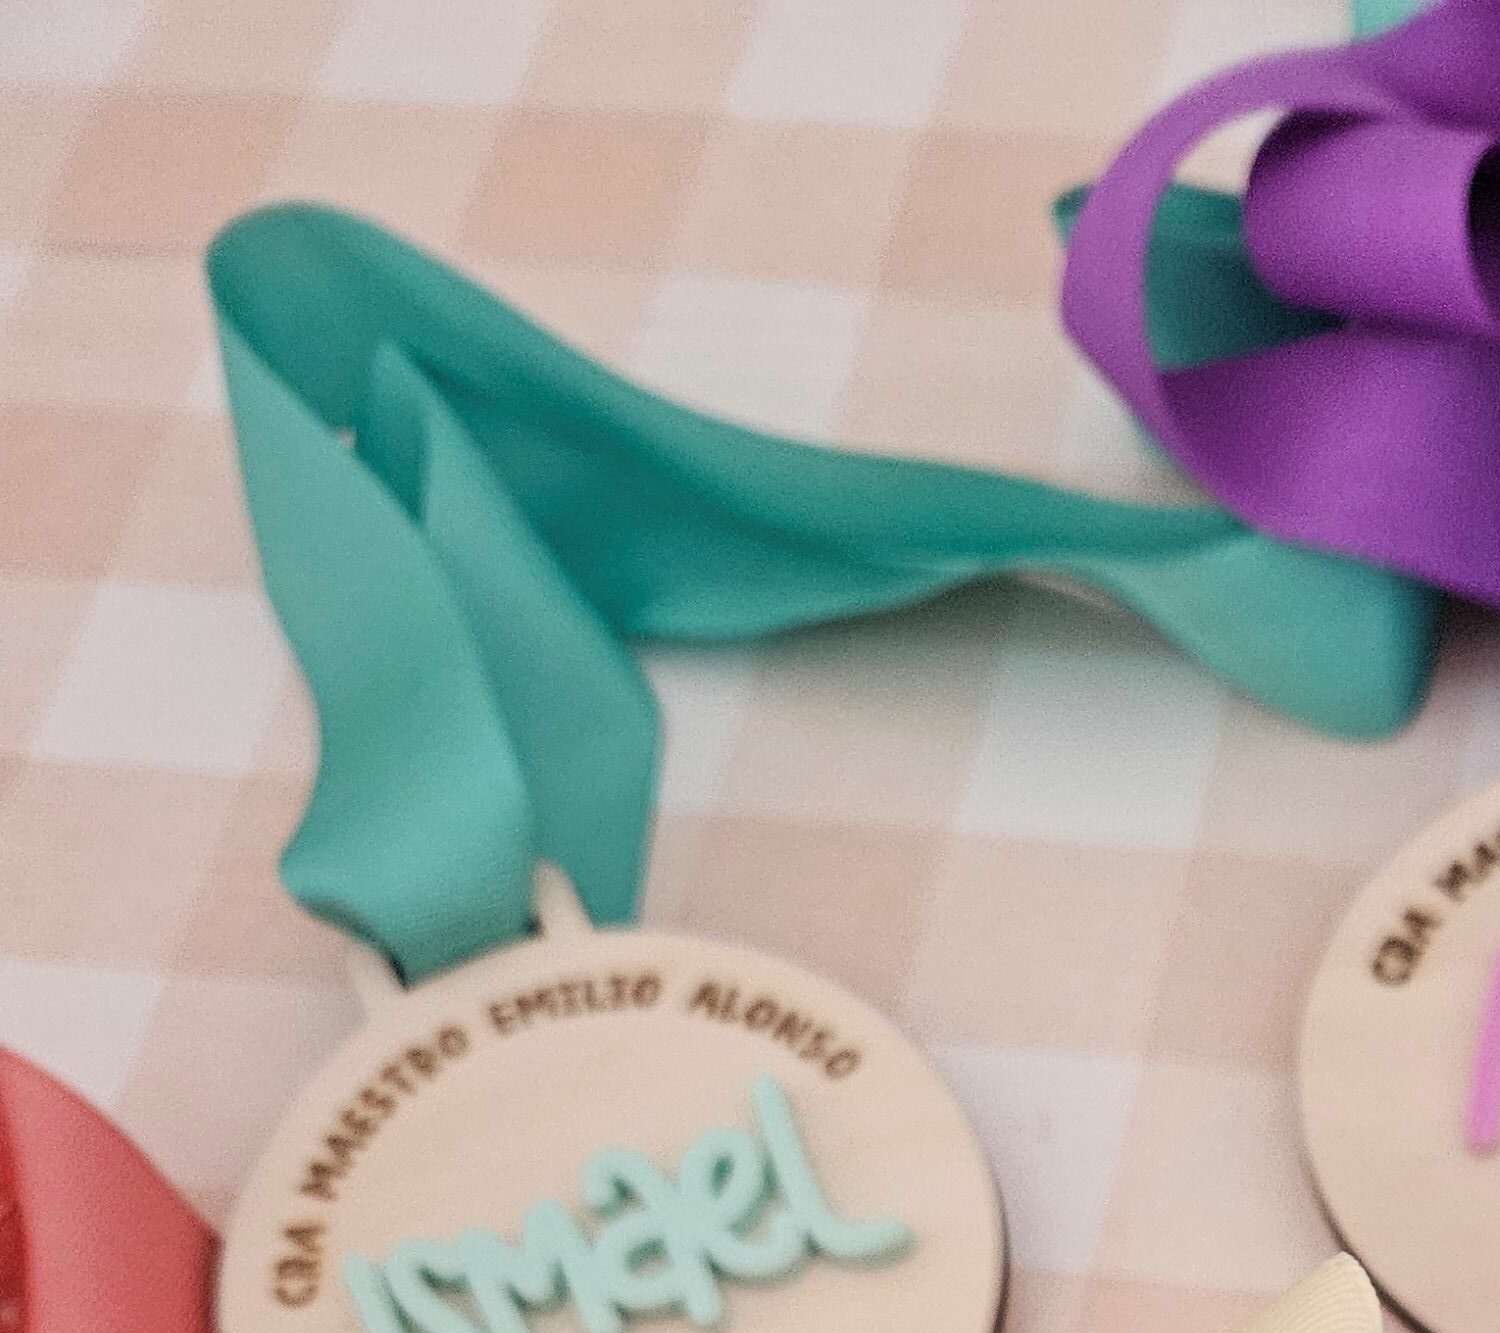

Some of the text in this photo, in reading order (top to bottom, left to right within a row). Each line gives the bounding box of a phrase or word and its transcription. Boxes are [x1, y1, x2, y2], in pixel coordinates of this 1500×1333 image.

[299, 1026, 471, 1201] MAESTRO
[488, 974, 662, 1036] EMILIO
[690, 980, 864, 1082] ALONSO
